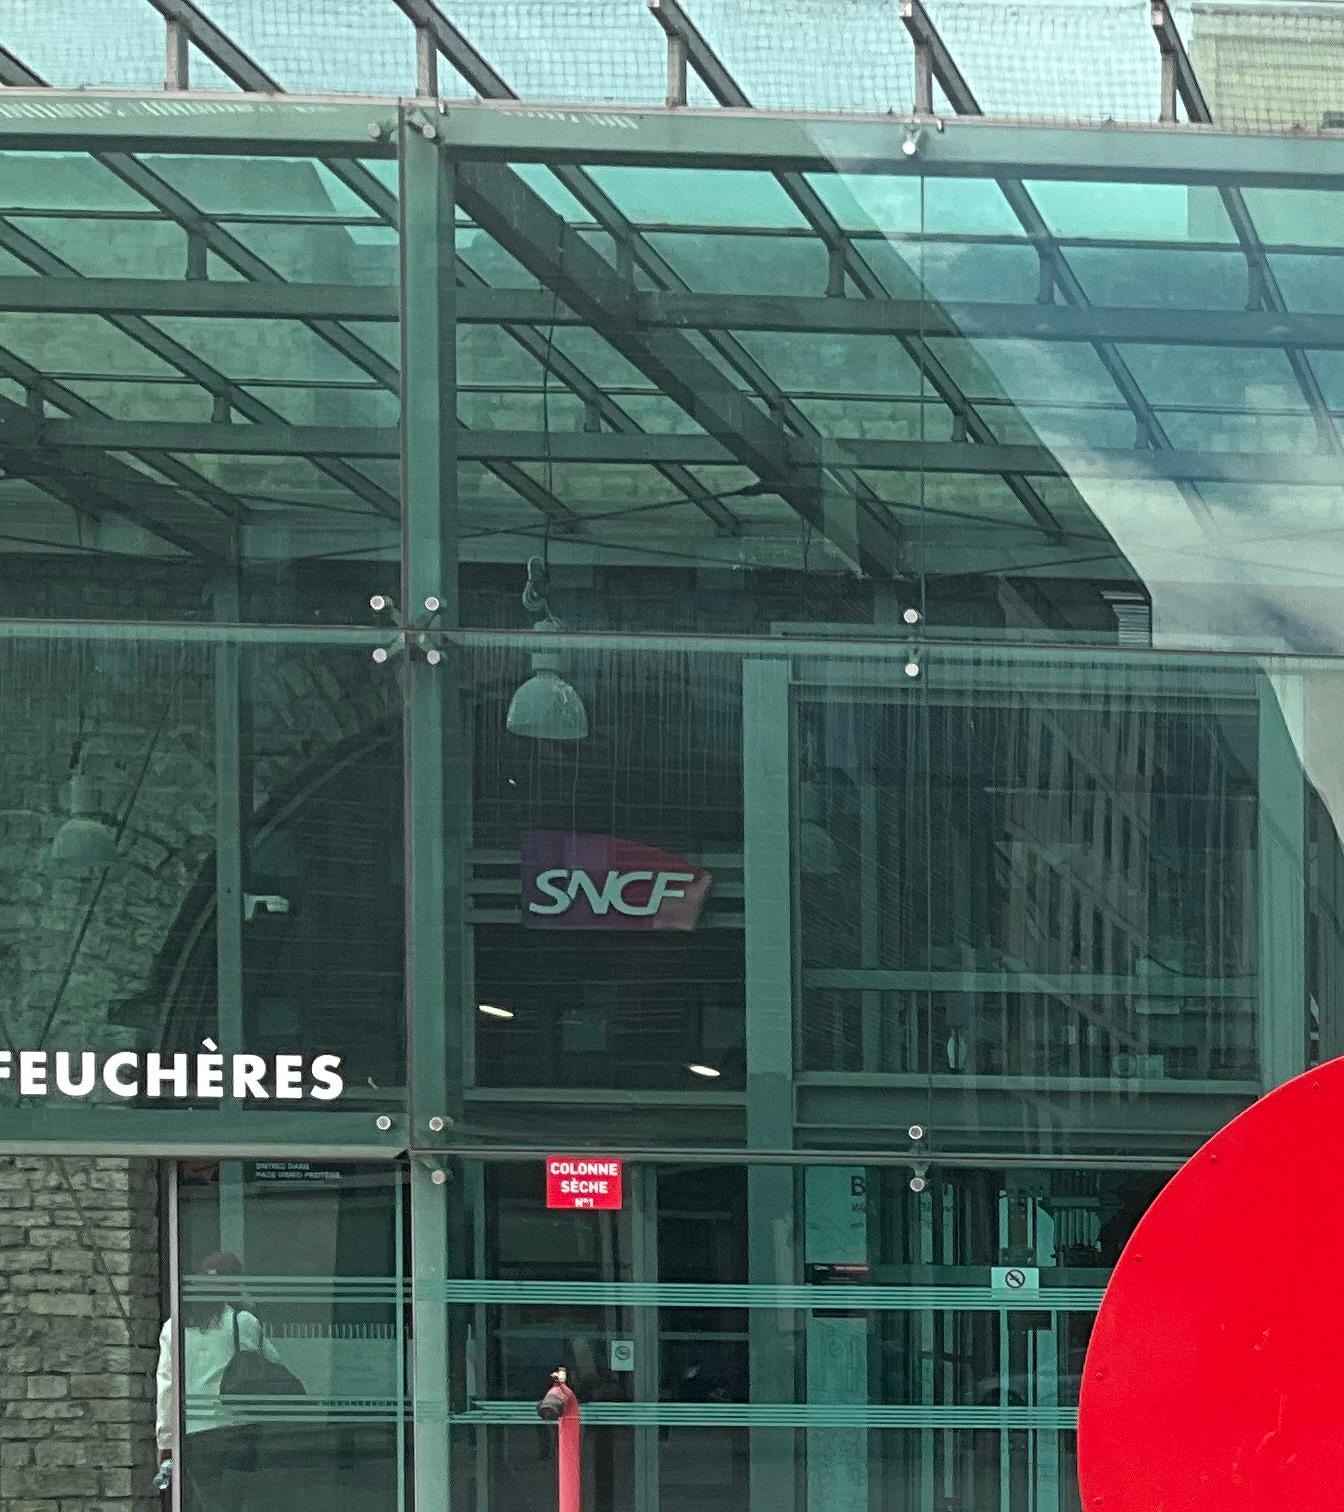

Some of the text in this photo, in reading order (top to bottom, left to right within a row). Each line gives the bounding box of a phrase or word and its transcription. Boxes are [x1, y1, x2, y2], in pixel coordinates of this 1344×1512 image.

[528, 868, 695, 917] SNCF
[550, 1162, 618, 1176] COLONNE
[560, 1178, 609, 1194] SÈCHE
